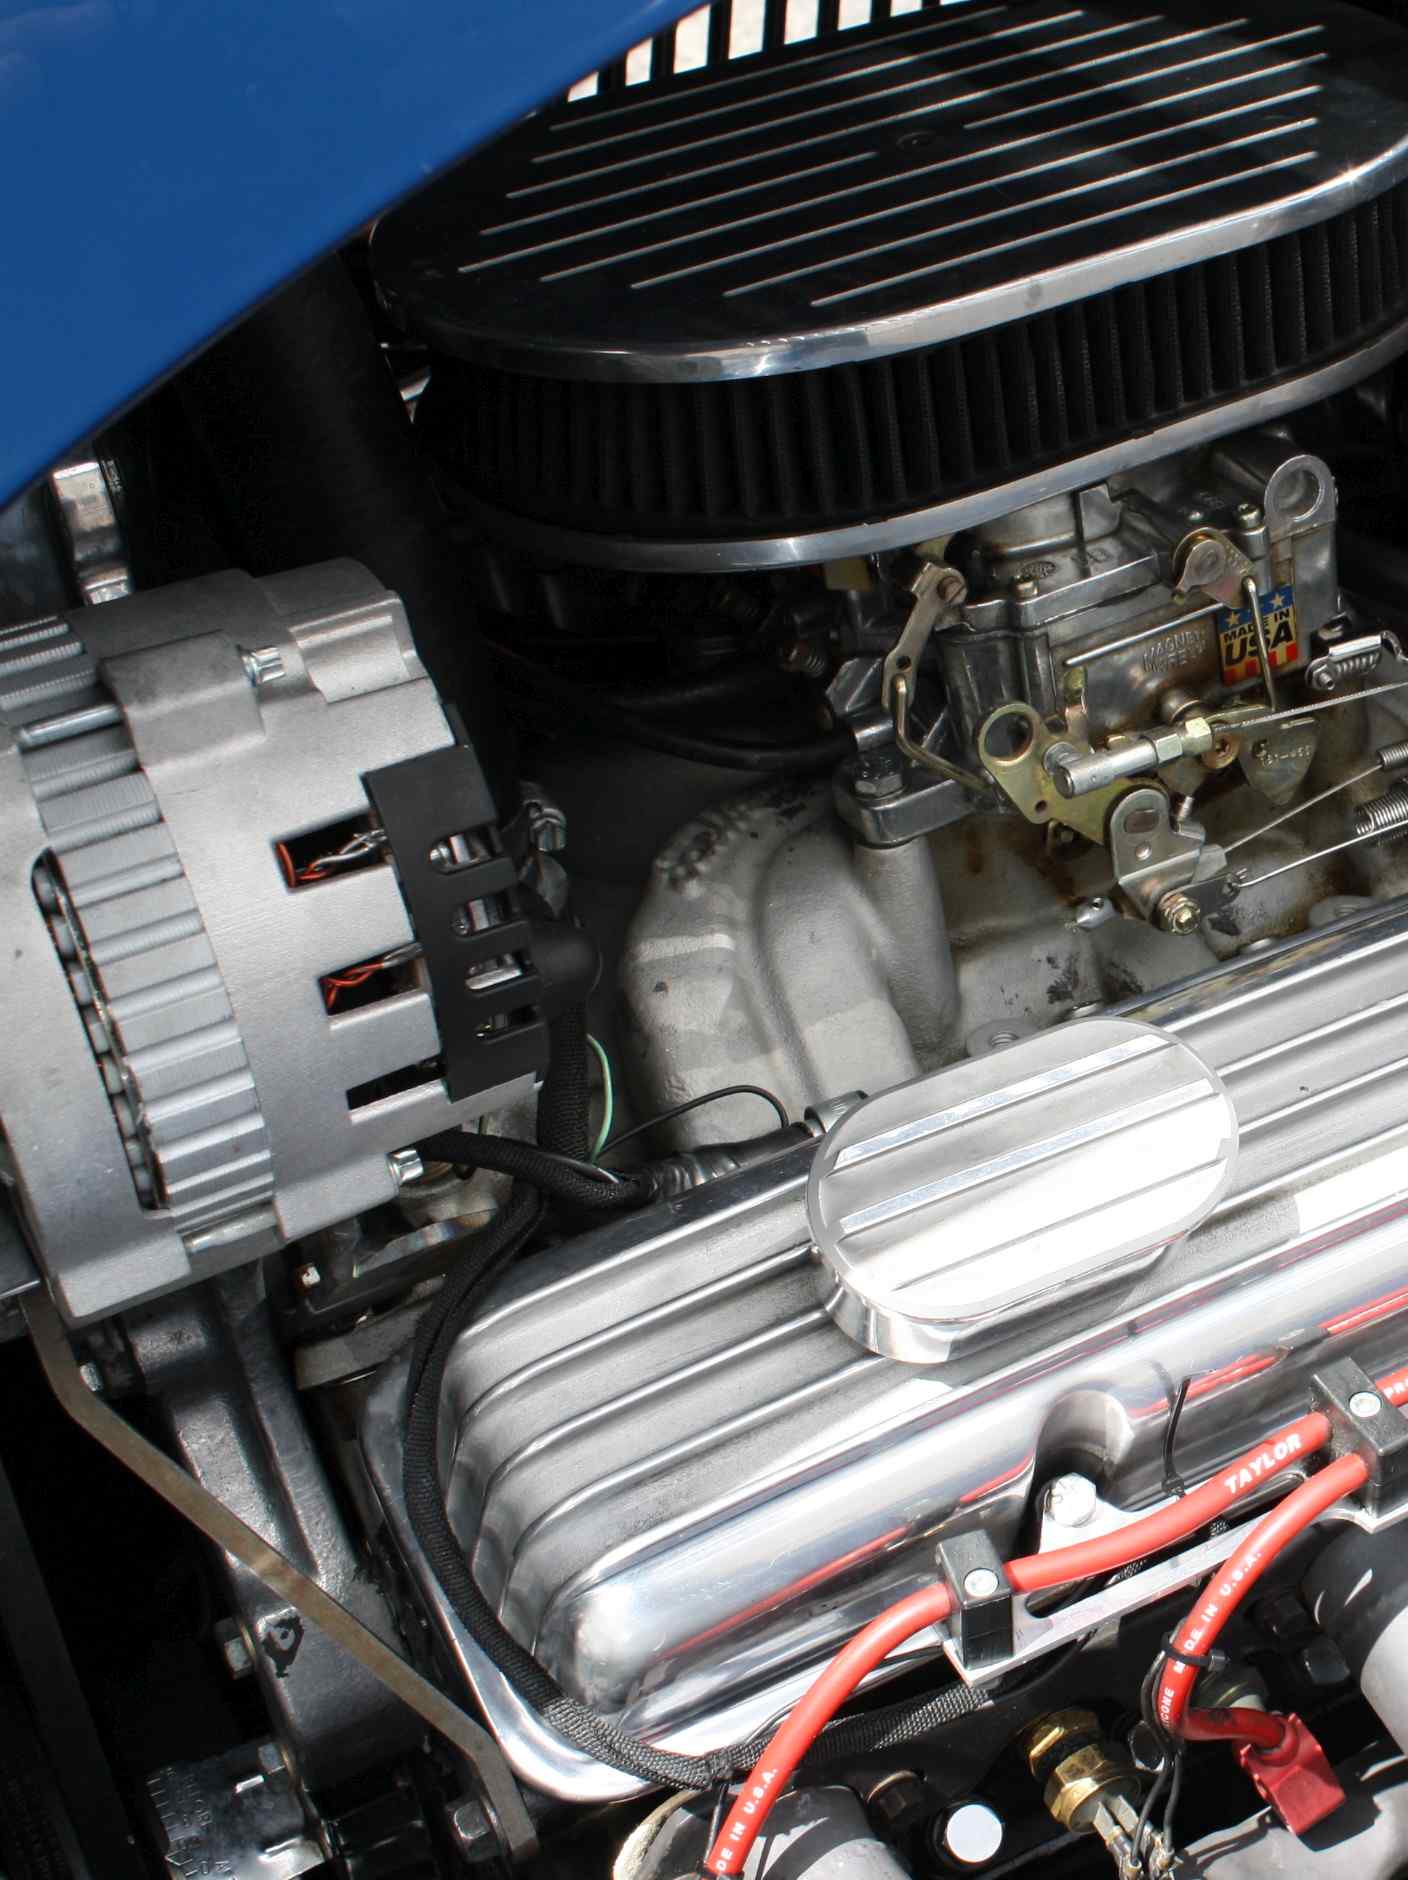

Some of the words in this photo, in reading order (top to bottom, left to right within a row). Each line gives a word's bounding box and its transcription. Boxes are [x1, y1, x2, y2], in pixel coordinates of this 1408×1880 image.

[1223, 617, 1269, 642] MADE
[1274, 609, 1290, 622] IN
[1225, 621, 1294, 666] USA
[1224, 1432, 1303, 1495] TAYLOR
[1173, 1629, 1202, 1674] MDE
[1200, 1602, 1219, 1623] IN
[1218, 1550, 1263, 1598] U.S.A.
[729, 1822, 746, 1841] IN
[743, 1767, 779, 1815] U.S.A.
